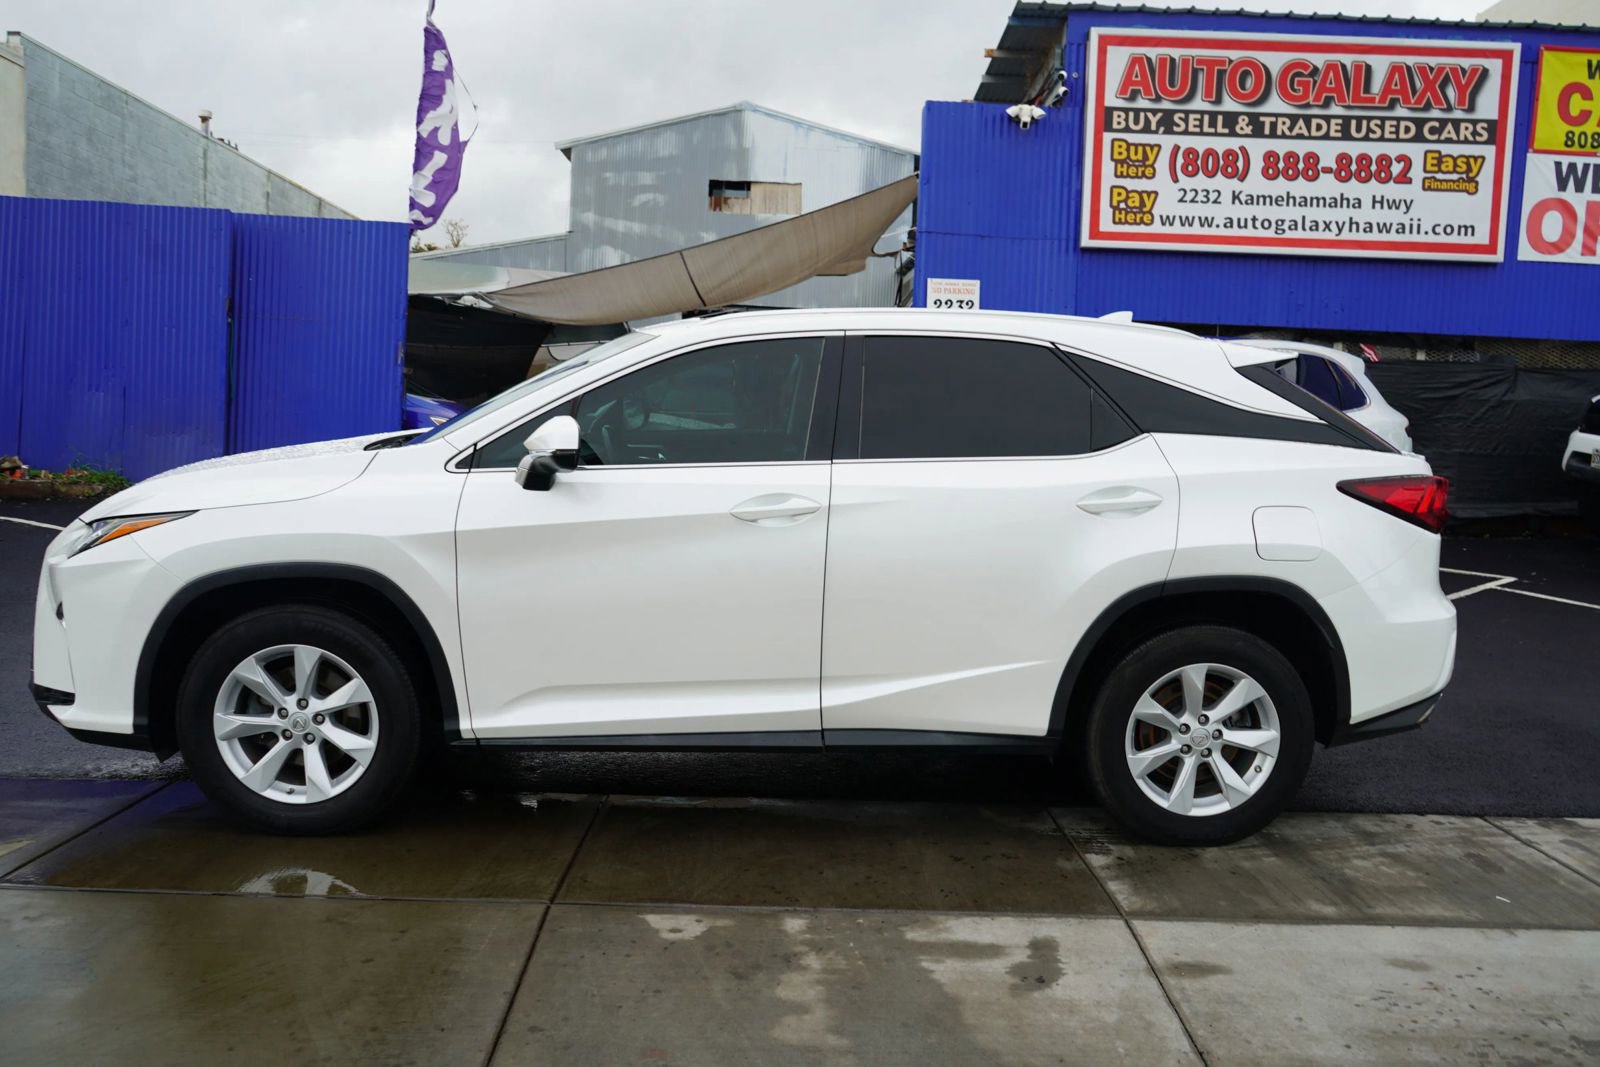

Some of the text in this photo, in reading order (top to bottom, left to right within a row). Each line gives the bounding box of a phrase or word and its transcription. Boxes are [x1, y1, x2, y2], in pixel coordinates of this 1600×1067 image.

[1115, 53, 1485, 111] AUTO GALAXY
[1557, 81, 1600, 127] C
[1112, 110, 1489, 142] BUY, SELL & TRADE USED CARS
[1112, 139, 1160, 165] Buy
[1169, 144, 1412, 185] (808) 888-8882
[1425, 151, 1483, 177] Easy
[1116, 163, 1154, 178] Here
[1424, 178, 1477, 193] Financing
[1111, 187, 1157, 211] Pay
[1177, 188, 1414, 214] 2232 Kamehamaha Hwy
[1114, 210, 1153, 224] Here
[1159, 214, 1475, 237] www.autogalaxyhawaii.com
